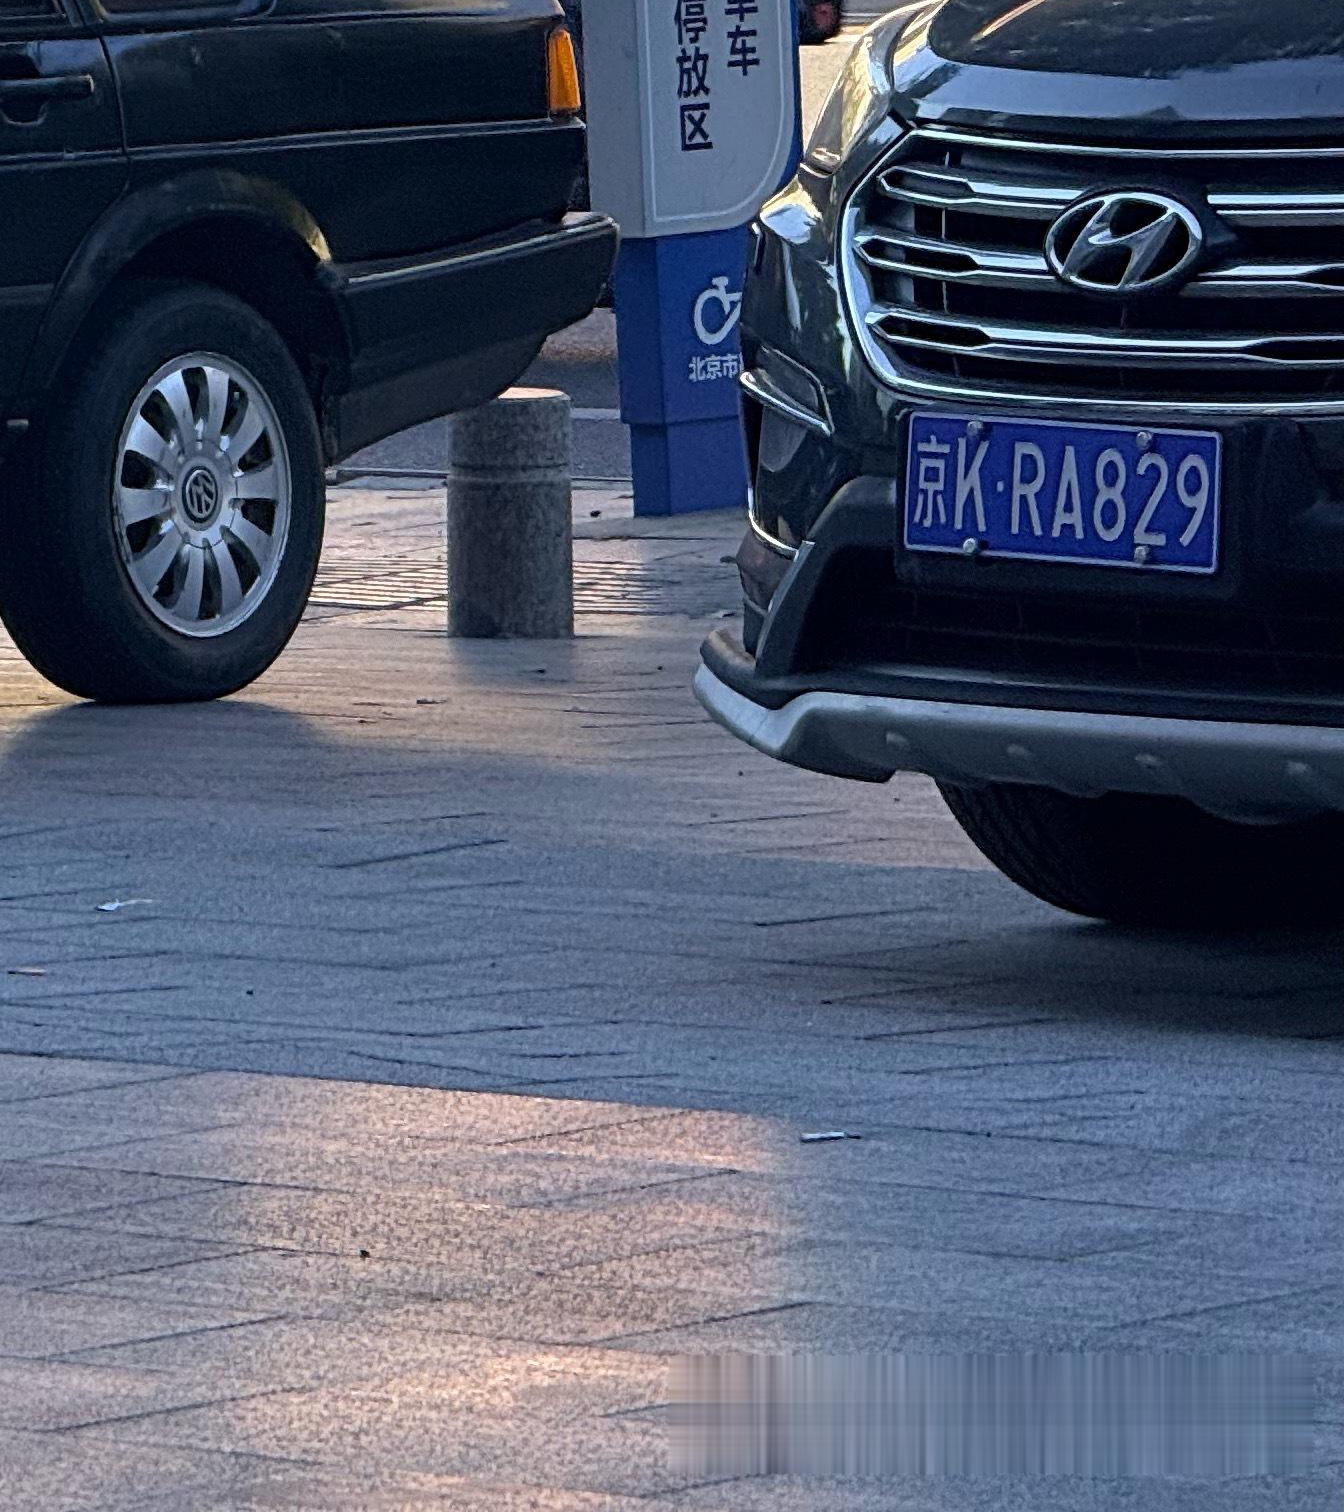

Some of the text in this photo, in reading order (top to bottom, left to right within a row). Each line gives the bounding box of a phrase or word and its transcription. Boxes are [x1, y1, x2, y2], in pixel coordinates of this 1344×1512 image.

[688, 351, 745, 383] 北京市
[913, 434, 1210, 548] 京K·RA829
